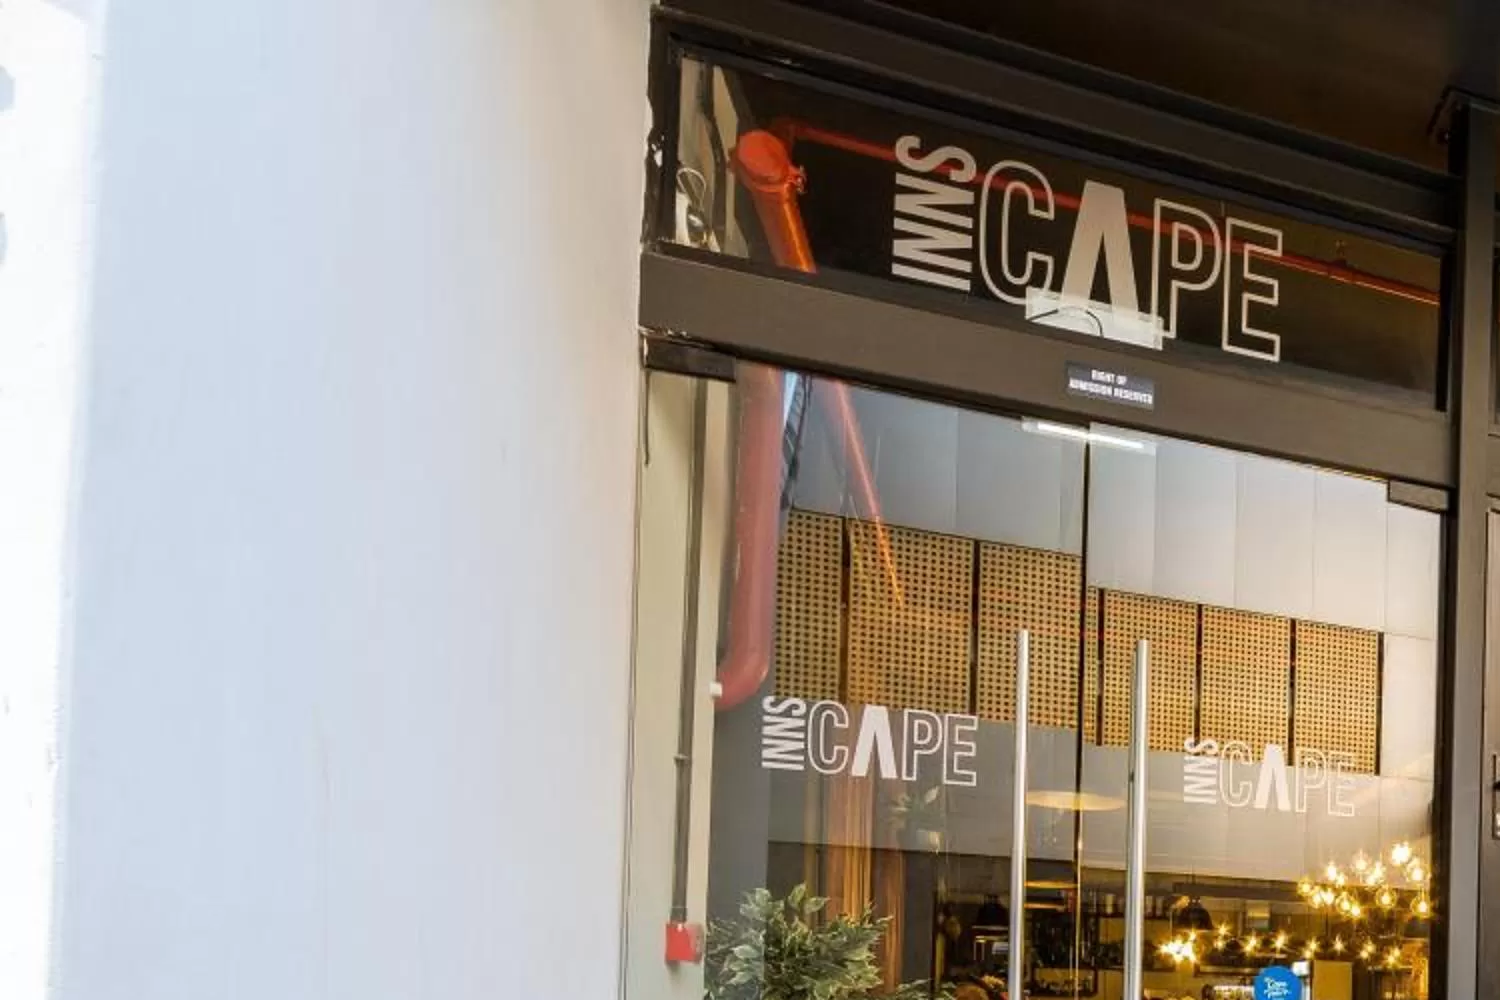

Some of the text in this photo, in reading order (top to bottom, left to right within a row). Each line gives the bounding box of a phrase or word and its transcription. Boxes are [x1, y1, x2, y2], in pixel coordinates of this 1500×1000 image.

[979, 160, 1283, 362] CAPE
[808, 700, 978, 786] CAPE
[1219, 740, 1356, 817] CAPE
